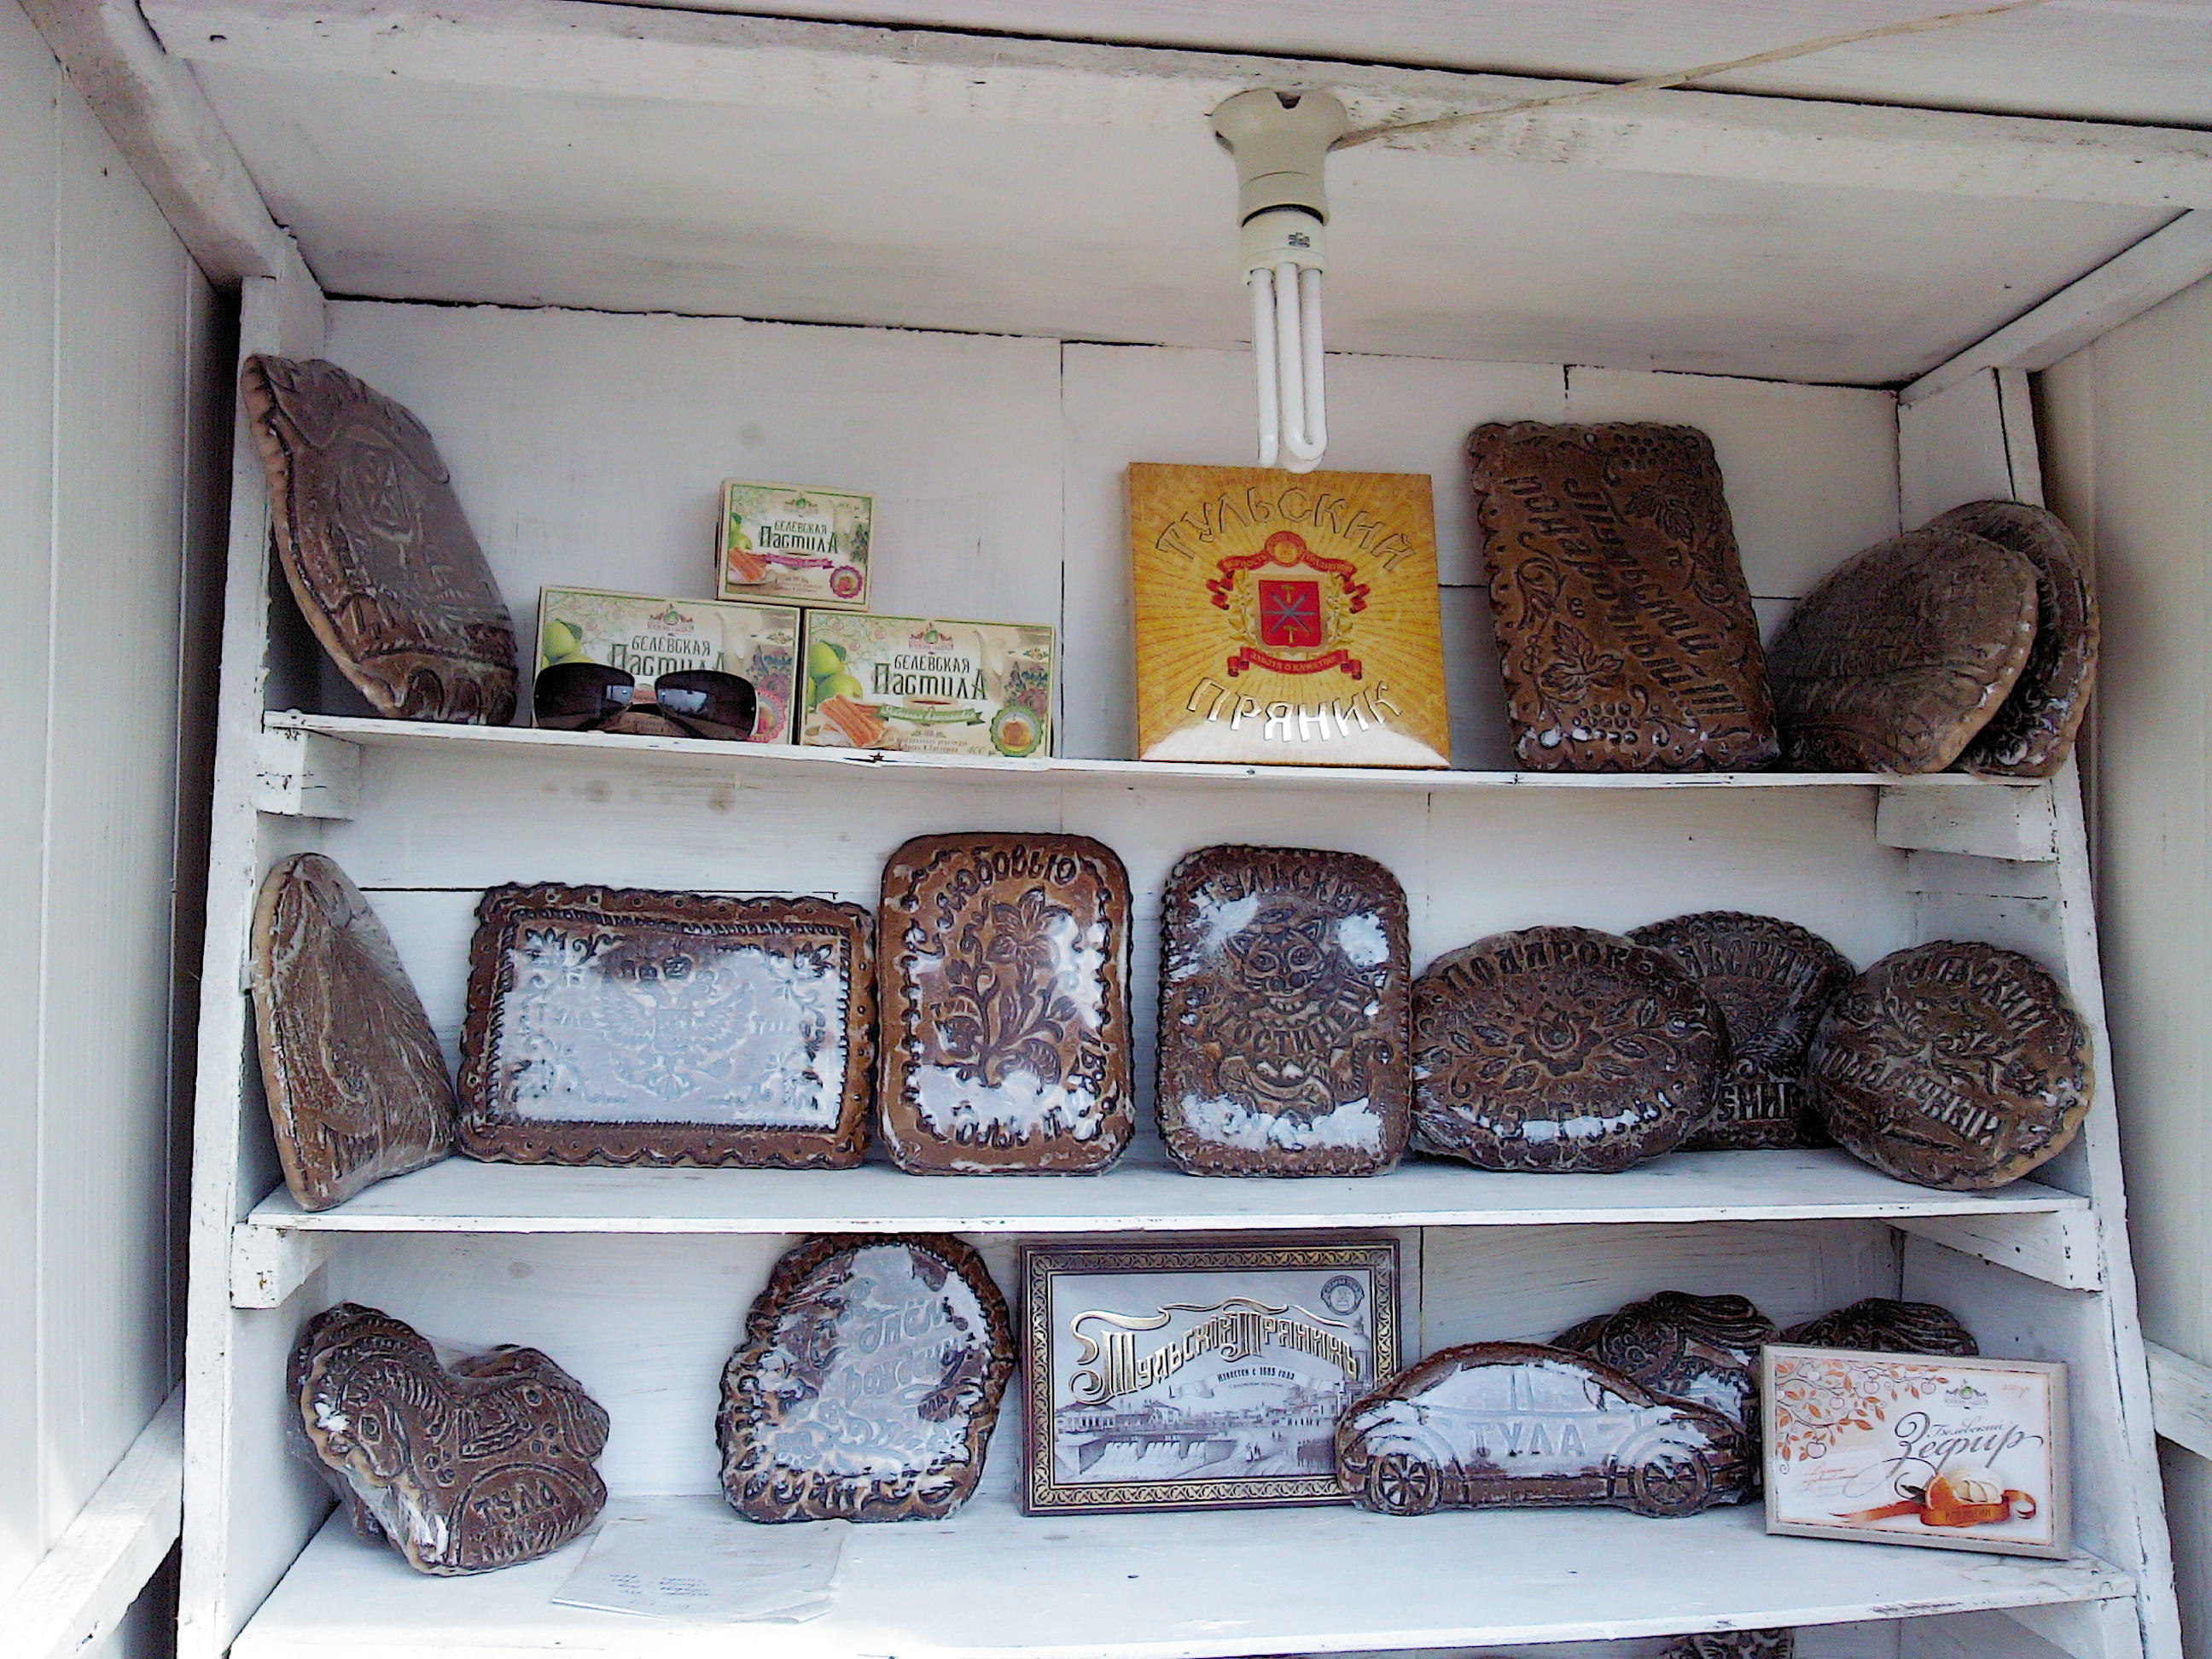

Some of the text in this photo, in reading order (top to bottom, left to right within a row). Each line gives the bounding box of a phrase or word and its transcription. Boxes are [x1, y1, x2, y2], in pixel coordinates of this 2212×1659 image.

[1155, 486, 1415, 572] ТУЛЬСКИЙ
[1185, 676, 1403, 743] ПРЯНИК
[1442, 940, 1628, 998] ПОДАРОК
